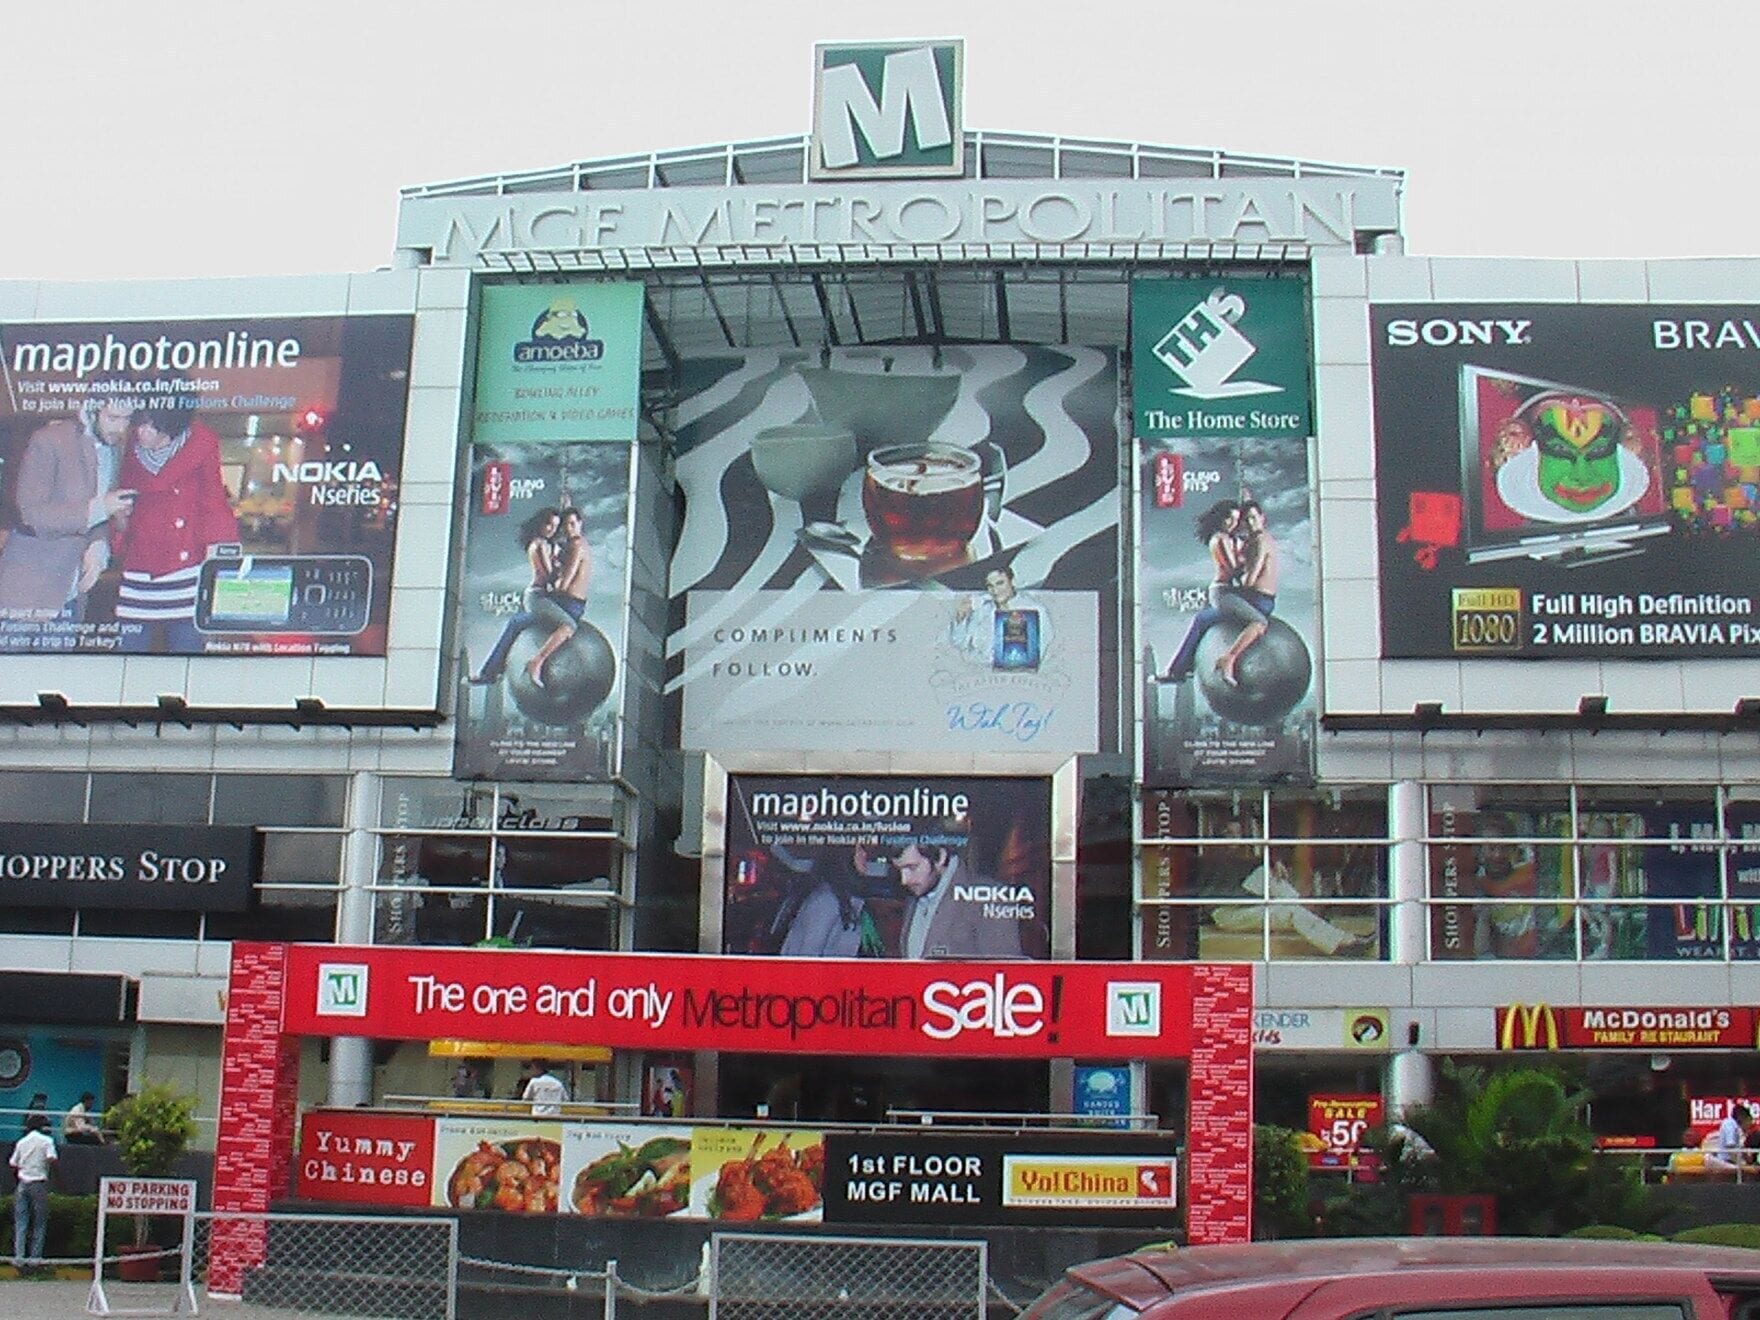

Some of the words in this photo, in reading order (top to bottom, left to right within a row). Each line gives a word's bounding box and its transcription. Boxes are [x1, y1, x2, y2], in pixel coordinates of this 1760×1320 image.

[822, 47, 951, 168] M
[440, 203, 624, 259] MGF
[655, 190, 1358, 248] METROPOLITAN
[1388, 320, 1531, 345] SONY
[13, 331, 301, 378] maphotonline
[517, 342, 599, 360] amoeba
[18, 381, 45, 393] Visit
[48, 379, 220, 394] www.nokia.co.in/fusion
[22, 399, 37, 410] to
[40, 398, 65, 412] join
[68, 398, 80, 409] in
[83, 398, 105, 410] the
[107, 397, 146, 410] Nokia
[149, 396, 175, 409] N78
[1145, 411, 1183, 429] The
[1188, 411, 1245, 429] Home
[1250, 411, 1300, 429] Store
[272, 461, 382, 482] NOKIA
[311, 484, 380, 505] Nseries
[1532, 594, 1573, 614] Full
[1580, 594, 1632, 618] High
[1639, 593, 1751, 614] Definition
[713, 627, 898, 644] COMPLIMENTS
[1459, 613, 1516, 644] 1080
[1532, 623, 1547, 644] 2
[1553, 622, 1632, 644] Million
[1639, 622, 1724, 644] BRAVIA
[713, 661, 818, 677] FOLLOW.
[752, 788, 969, 820] maphotonline
[757, 821, 779, 831] Visit
[808, 834, 825, 844] the
[827, 834, 856, 845] Nokia
[0, 854, 124, 881] OPPERS
[139, 850, 227, 883] STOP
[953, 885, 1035, 902] NOKIA
[983, 903, 1035, 919] Nseries
[408, 975, 465, 1014] The
[472, 985, 528, 1014] one
[535, 978, 597, 1017] and
[608, 982, 674, 1029] only
[681, 986, 917, 1040] Metropolitan
[1583, 1010, 1730, 1029] McDonald's
[1593, 1030, 1635, 1043] FAMILY
[1324, 1108, 1366, 1119] SALE
[1690, 1099, 1723, 1119] Har
[316, 1130, 417, 1160] Yummy
[305, 1159, 425, 1187] Chinese
[849, 1153, 886, 1174] 1st
[892, 1155, 983, 1176] FLOOR
[108, 1182, 127, 1194] NO
[132, 1182, 190, 1196] PARKING
[847, 1181, 903, 1202] MGF
[910, 1183, 981, 1203] MALL
[107, 1196, 124, 1208] NO
[126, 1197, 188, 1210] STOPPING
